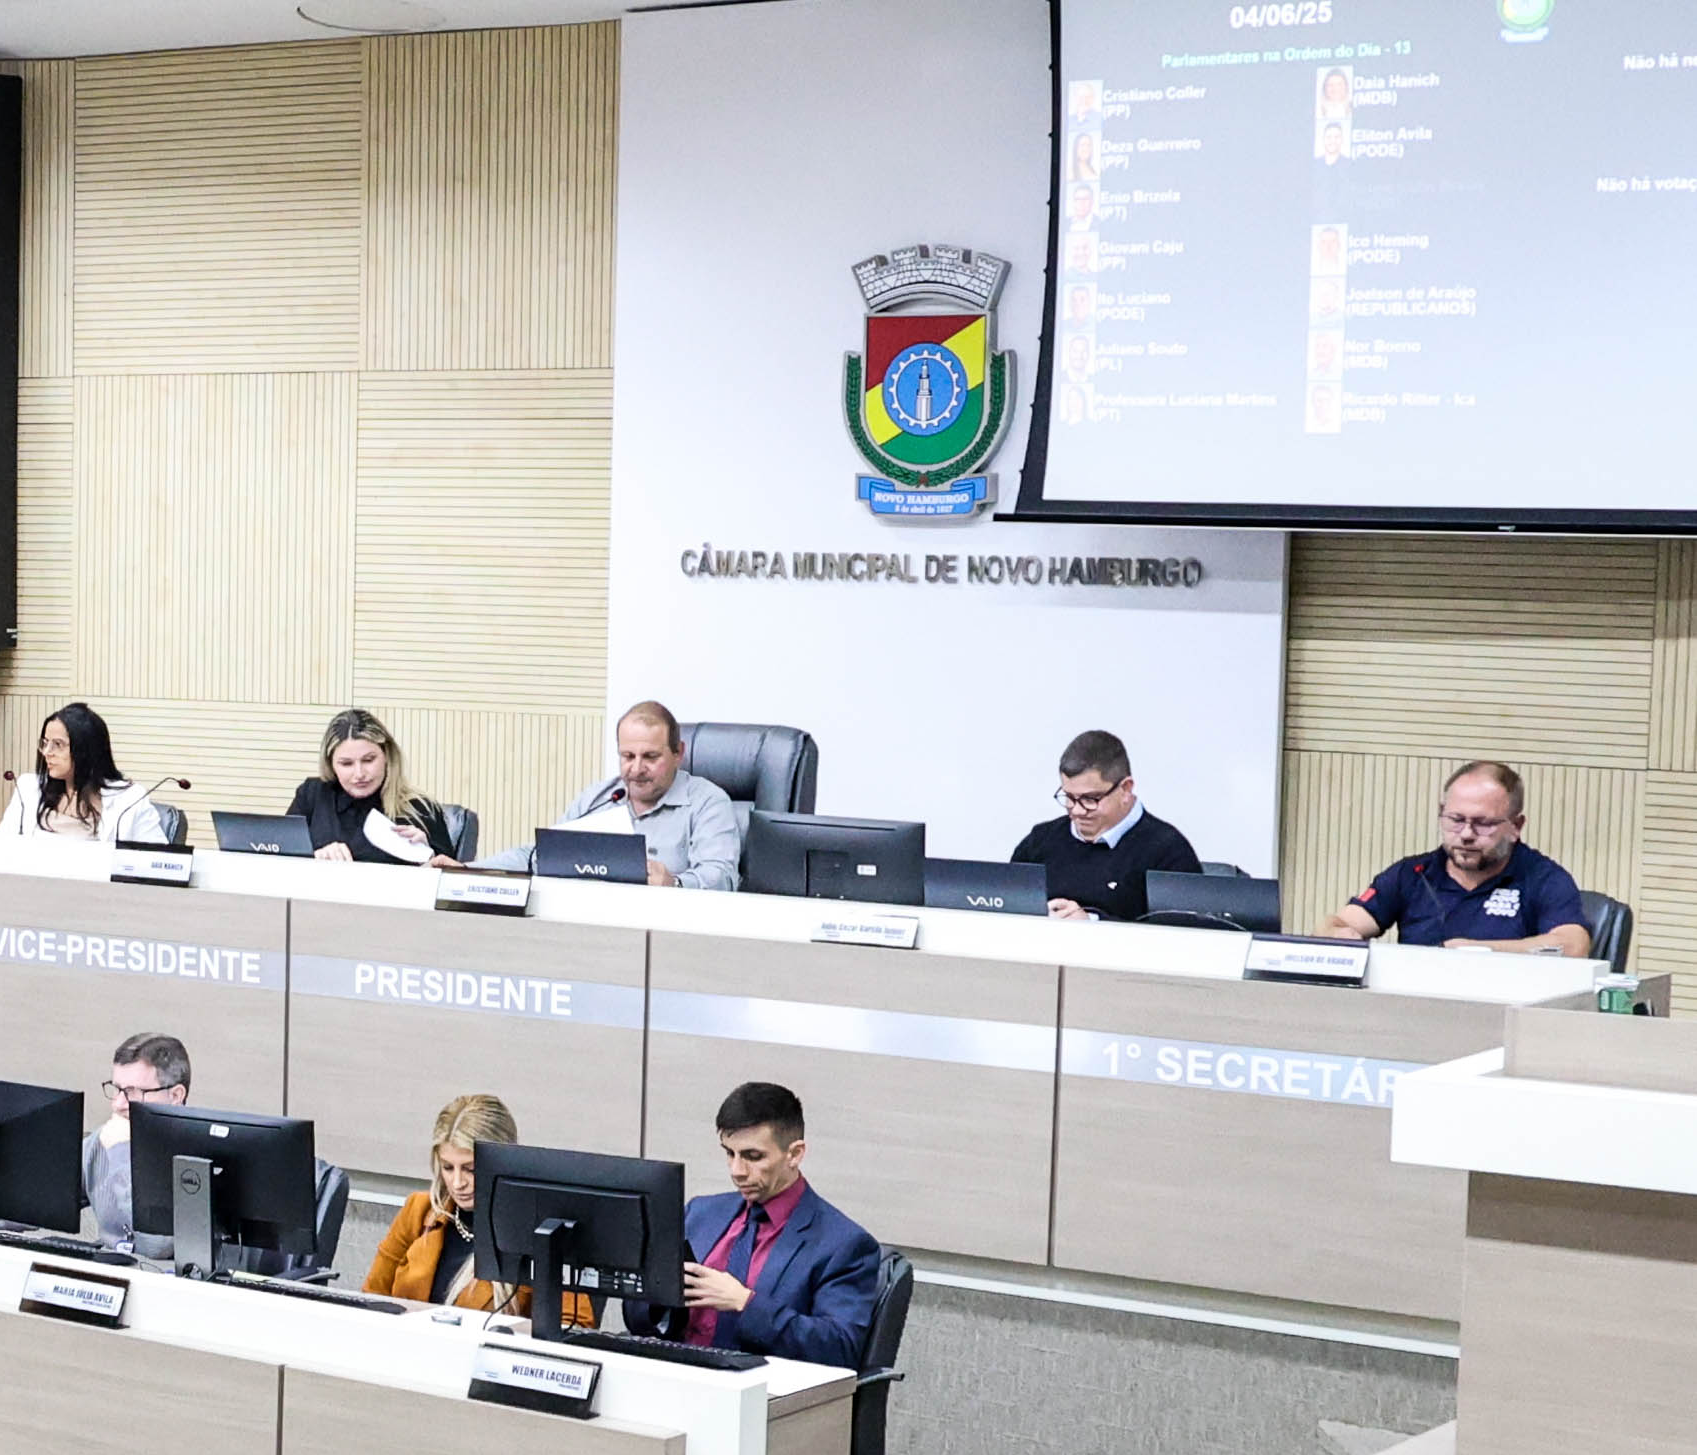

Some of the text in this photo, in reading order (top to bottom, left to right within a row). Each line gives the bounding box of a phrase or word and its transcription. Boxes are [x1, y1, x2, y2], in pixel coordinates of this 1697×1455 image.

[1229, 0, 1334, 28] 04/06/25
[1161, 51, 1260, 68] Parlamentares
[1263, 49, 1281, 63] na
[1284, 46, 1332, 62] Ordem
[1335, 46, 1354, 59] do
[1358, 43, 1382, 58] Dia
[1394, 40, 1412, 55] 13
[680, 541, 1208, 589] CÂMARA MUNICIPAL DE NOVO HAMBURGO
[249, 842, 280, 853] VAIO
[574, 863, 608, 876] VAIO
[966, 895, 1004, 908] VAIO
[354, 962, 574, 1018] PRESIDENTE
[1155, 1044, 1399, 1105] SECRETÁR
